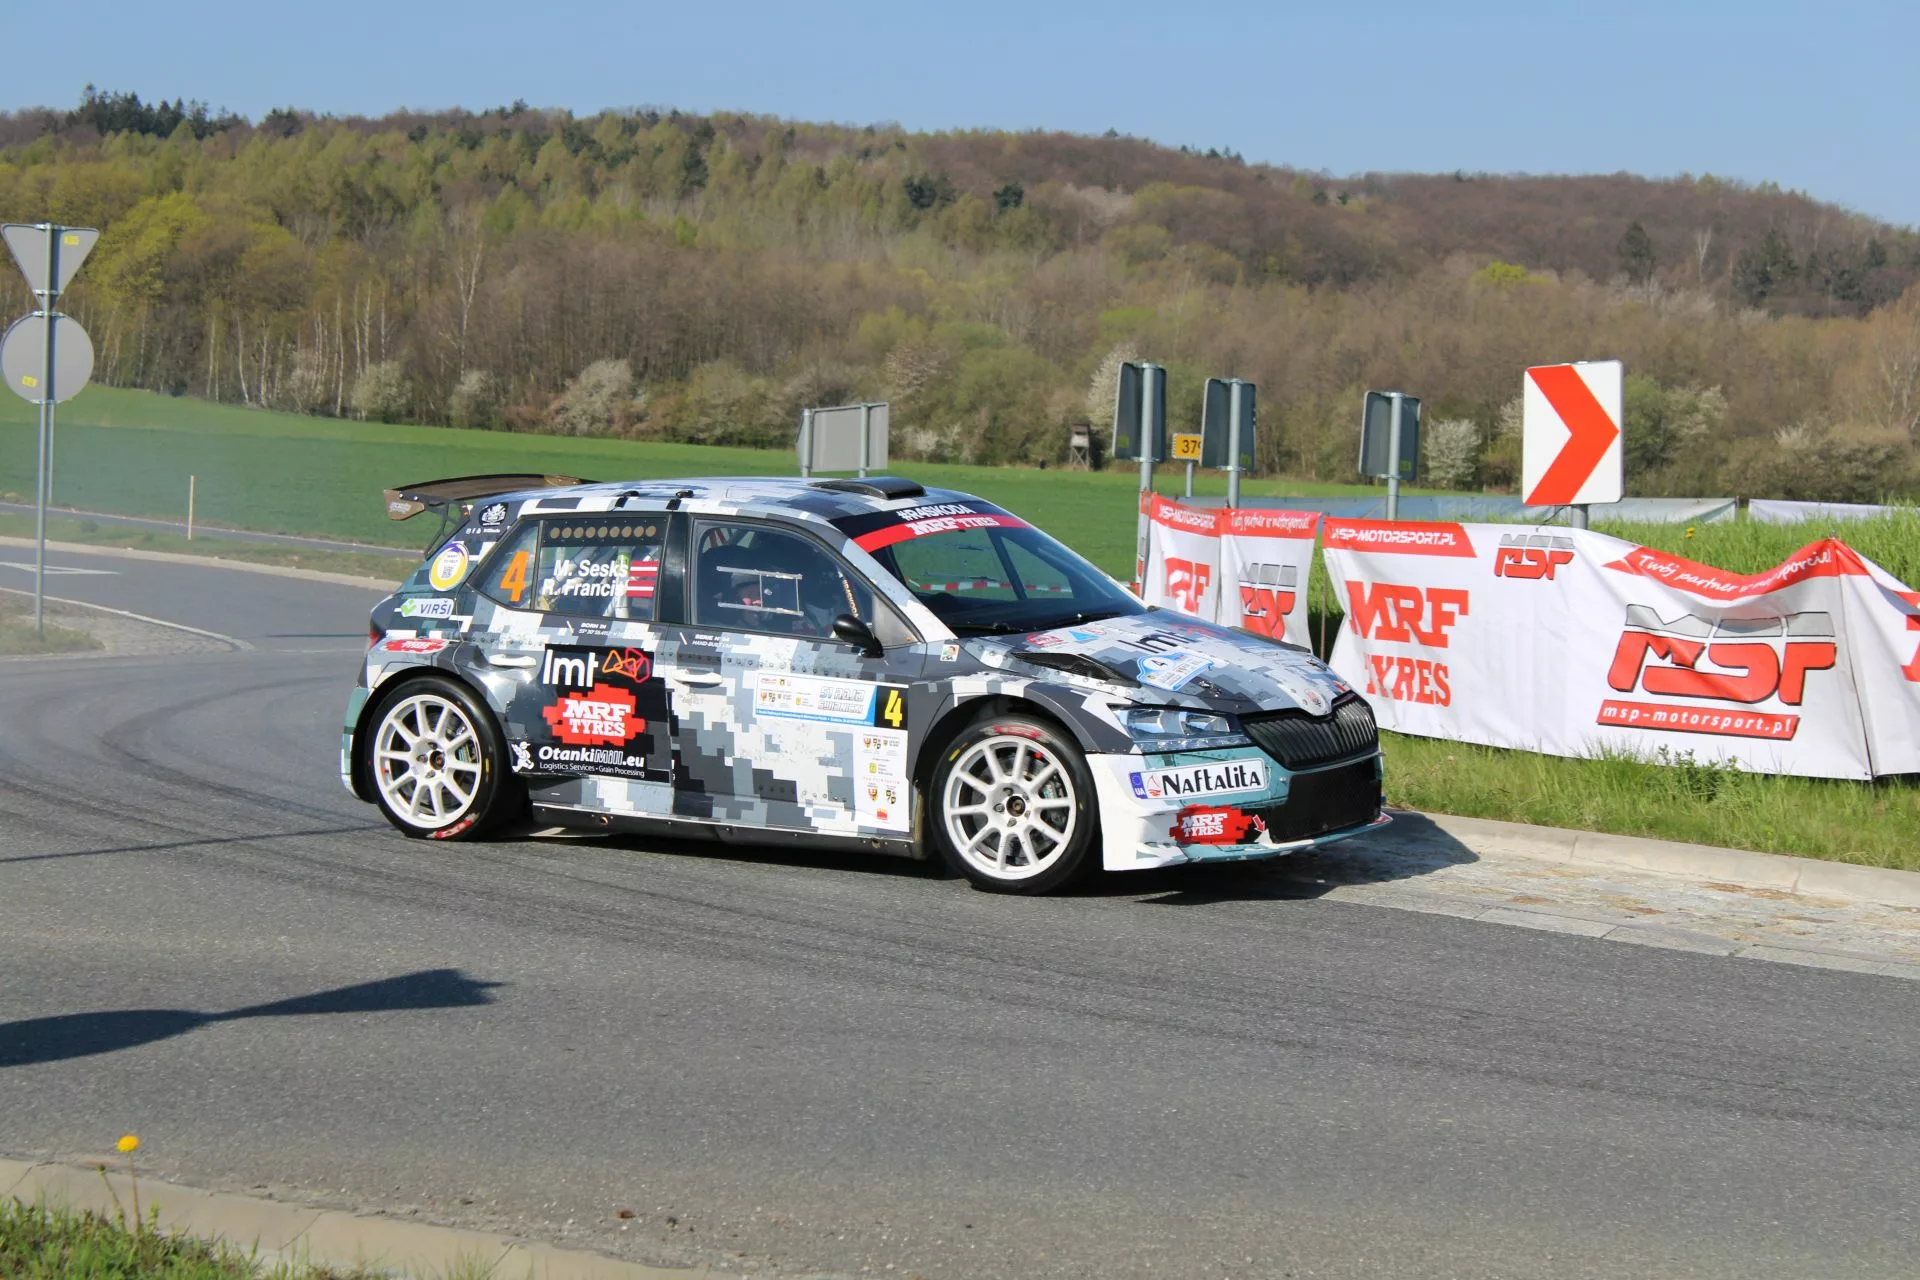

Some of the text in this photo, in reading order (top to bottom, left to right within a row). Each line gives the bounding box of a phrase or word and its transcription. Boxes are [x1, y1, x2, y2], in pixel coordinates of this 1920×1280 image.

[896, 504, 977, 521] #R4SKODA
[905, 517, 960, 536] MRF
[500, 551, 529, 602] 4
[553, 559, 629, 577] M. Sesks
[1638, 554, 1680, 578] Twój
[1676, 572, 1740, 593] partner
[541, 578, 561, 597] R.
[420, 601, 452, 615] VIRŠI
[1345, 580, 1469, 648] MRF
[542, 649, 599, 687] lmt
[562, 699, 631, 722] MRF
[884, 689, 904, 728] 4
[569, 718, 626, 737] TYRES
[1602, 705, 1791, 734] msp-motorsport.pl
[539, 762, 645, 779] Logistics Services Grain Processing
[1134, 787, 1147, 796] UA
[1182, 812, 1228, 829] MRF
[1183, 826, 1224, 838] TYRES
